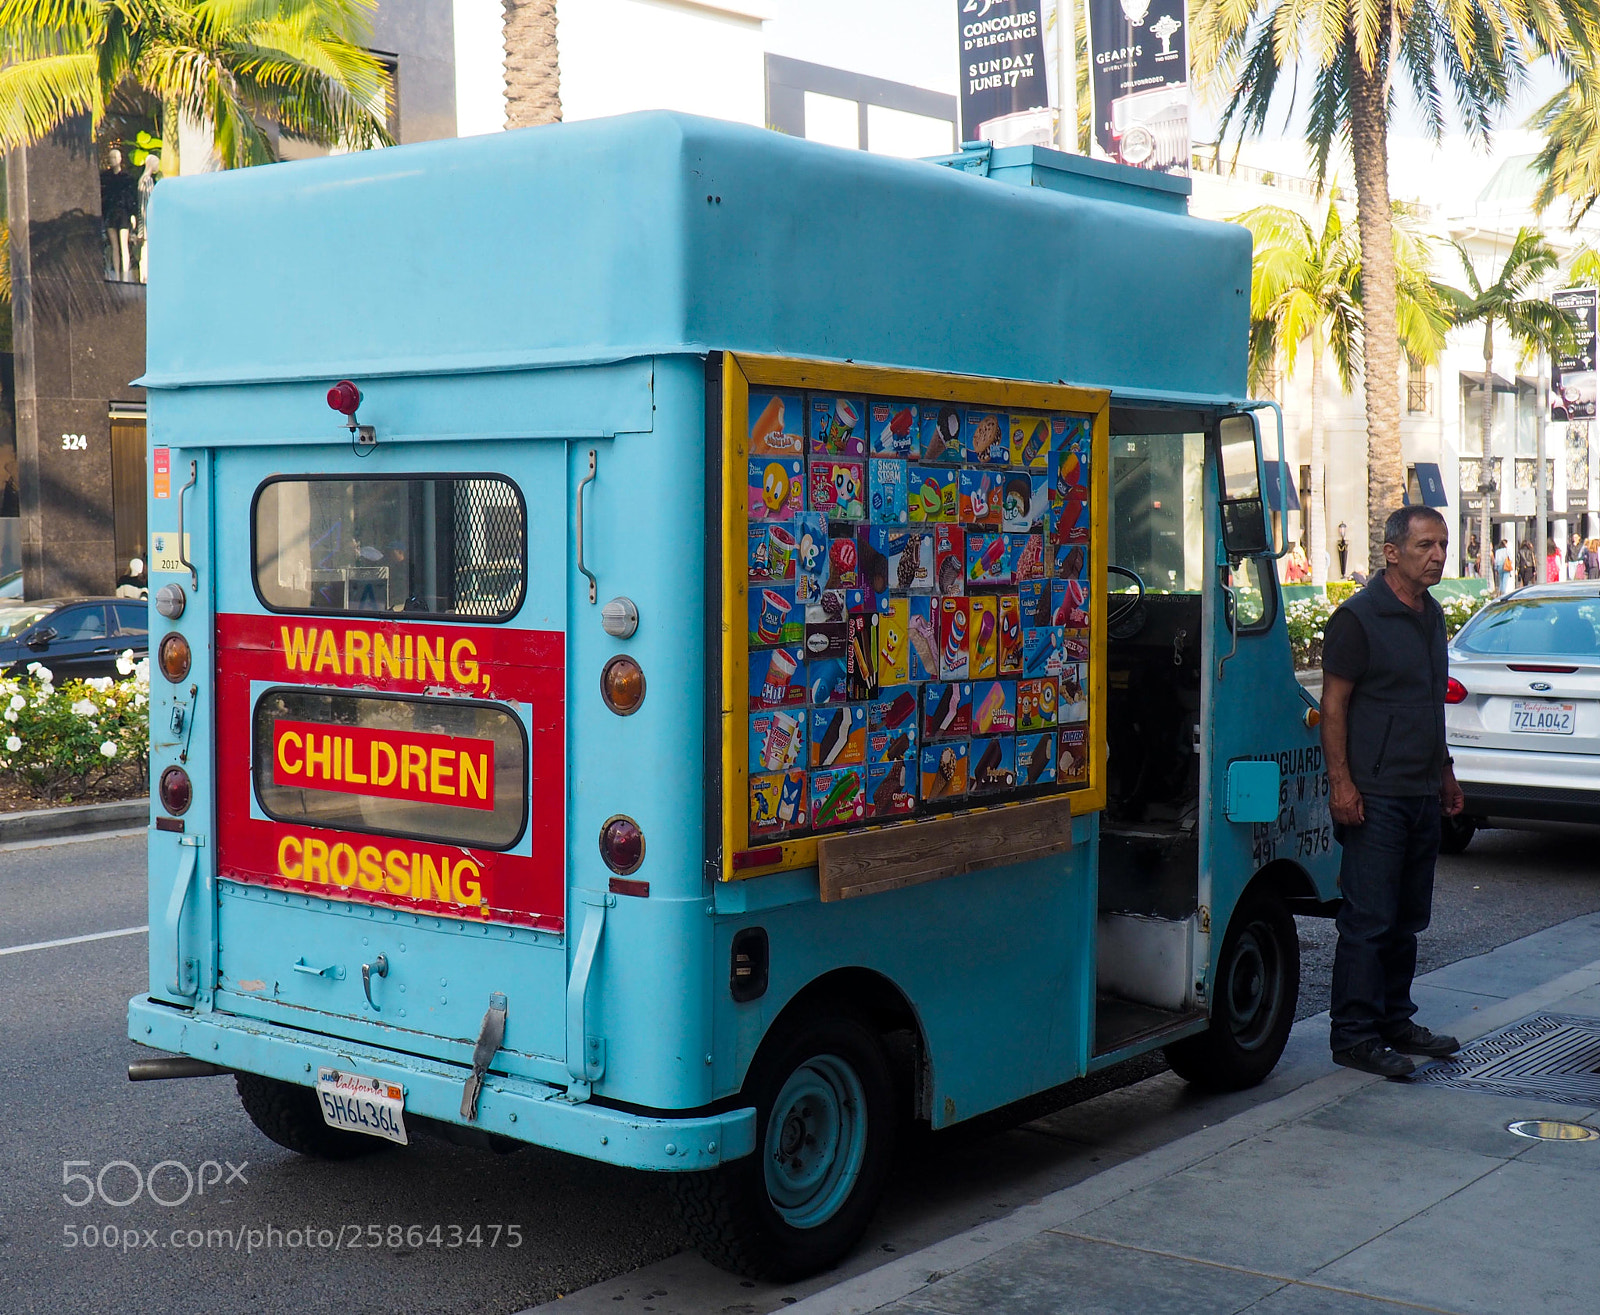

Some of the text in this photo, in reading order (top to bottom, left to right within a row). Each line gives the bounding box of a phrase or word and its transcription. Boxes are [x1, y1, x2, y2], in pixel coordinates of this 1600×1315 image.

[963, 11, 1037, 37] CONCOURS
[964, 27, 1038, 50] D'ELEGANCE
[969, 53, 1034, 77] SUNDAY
[1096, 45, 1143, 64] GEARYS
[970, 74, 1002, 95] JUNE
[61, 433, 88, 450] 324
[877, 459, 900, 470] SNOW
[877, 470, 901, 484] STORM
[161, 559, 180, 570] 2017
[281, 626, 491, 693] WARNING,
[992, 716, 1009, 725] Candy
[1514, 711, 1570, 729] 7ZLA042
[278, 731, 488, 800] CHILDREN
[1254, 745, 1322, 777] GUARD
[1297, 826, 1329, 858] 7576
[278, 835, 482, 905] CROSSING
[336, 1074, 386, 1098] California
[322, 1092, 400, 1135] 5H64364
